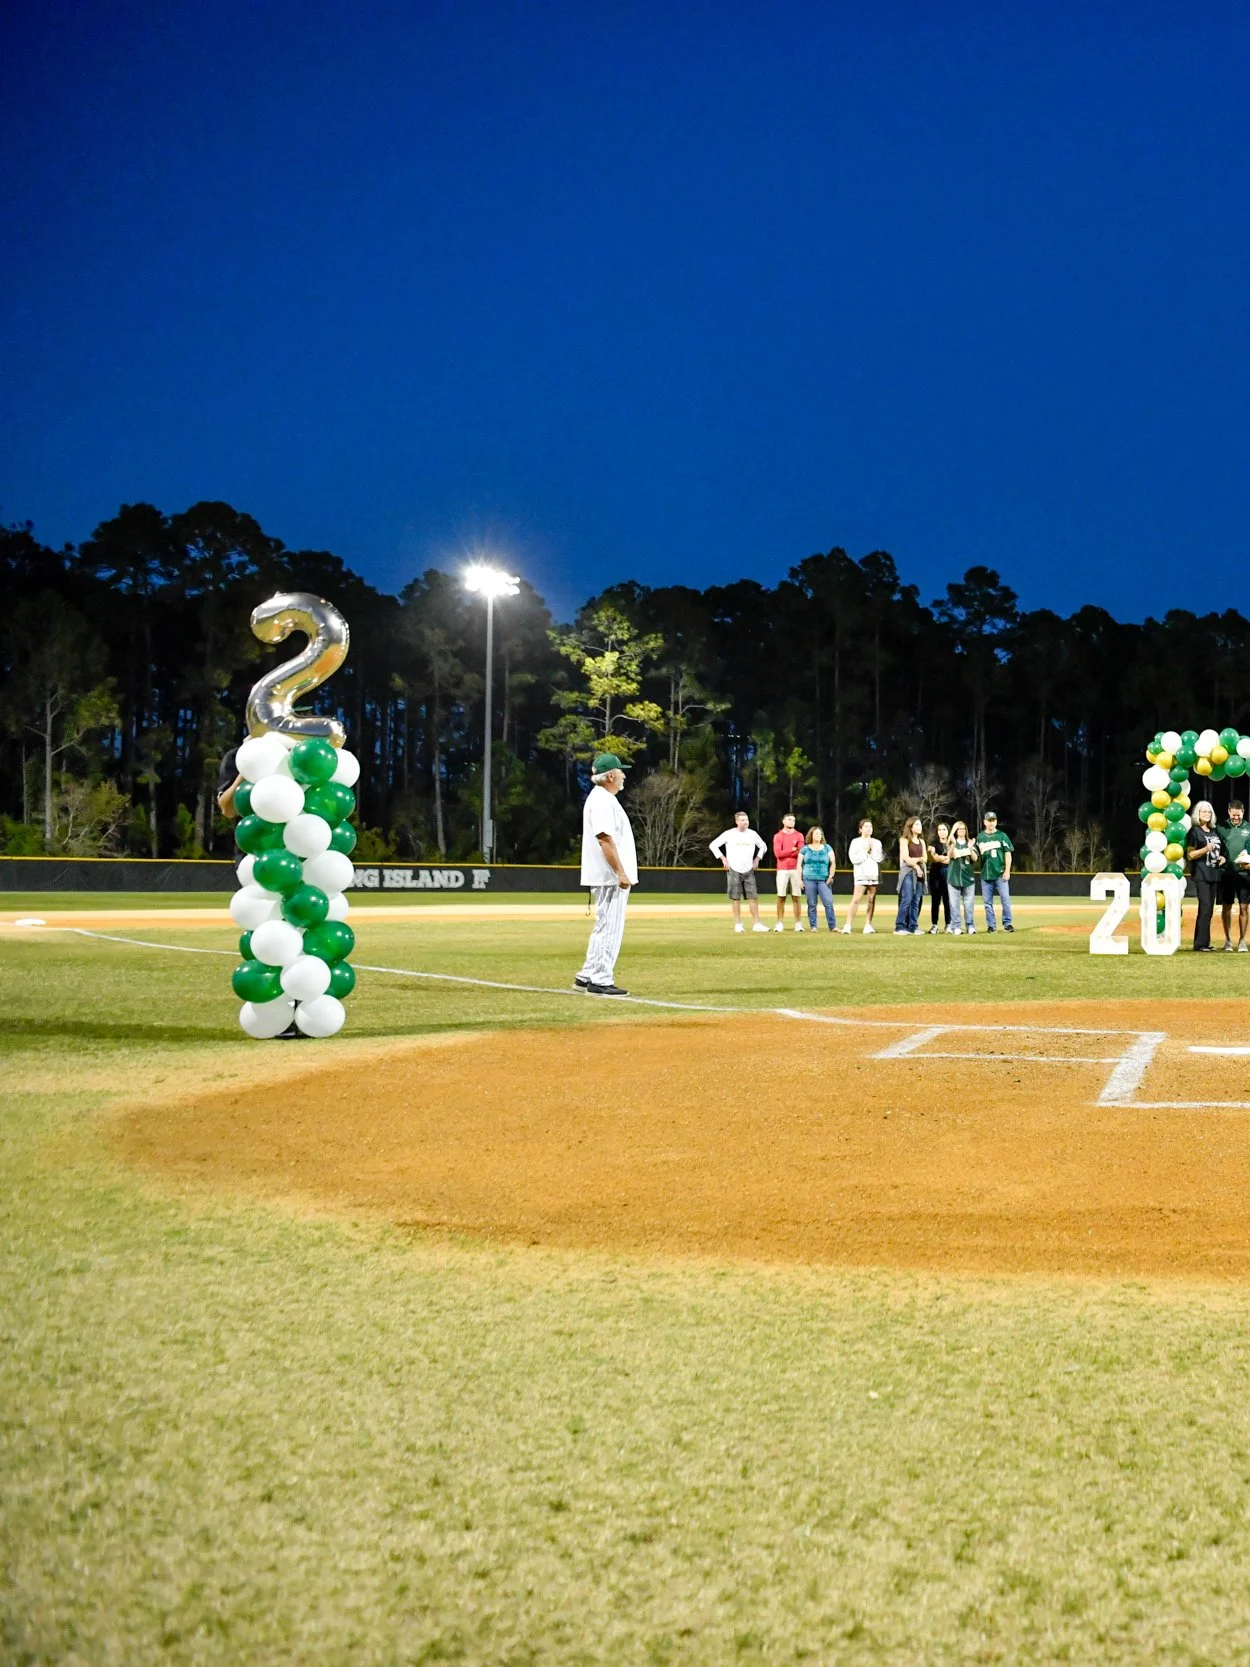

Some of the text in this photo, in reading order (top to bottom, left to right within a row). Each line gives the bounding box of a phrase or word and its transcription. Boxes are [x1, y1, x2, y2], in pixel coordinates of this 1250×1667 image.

[247, 592, 349, 747] 2
[382, 869, 464, 888] ISLAND
[1089, 872, 1182, 956] 20
